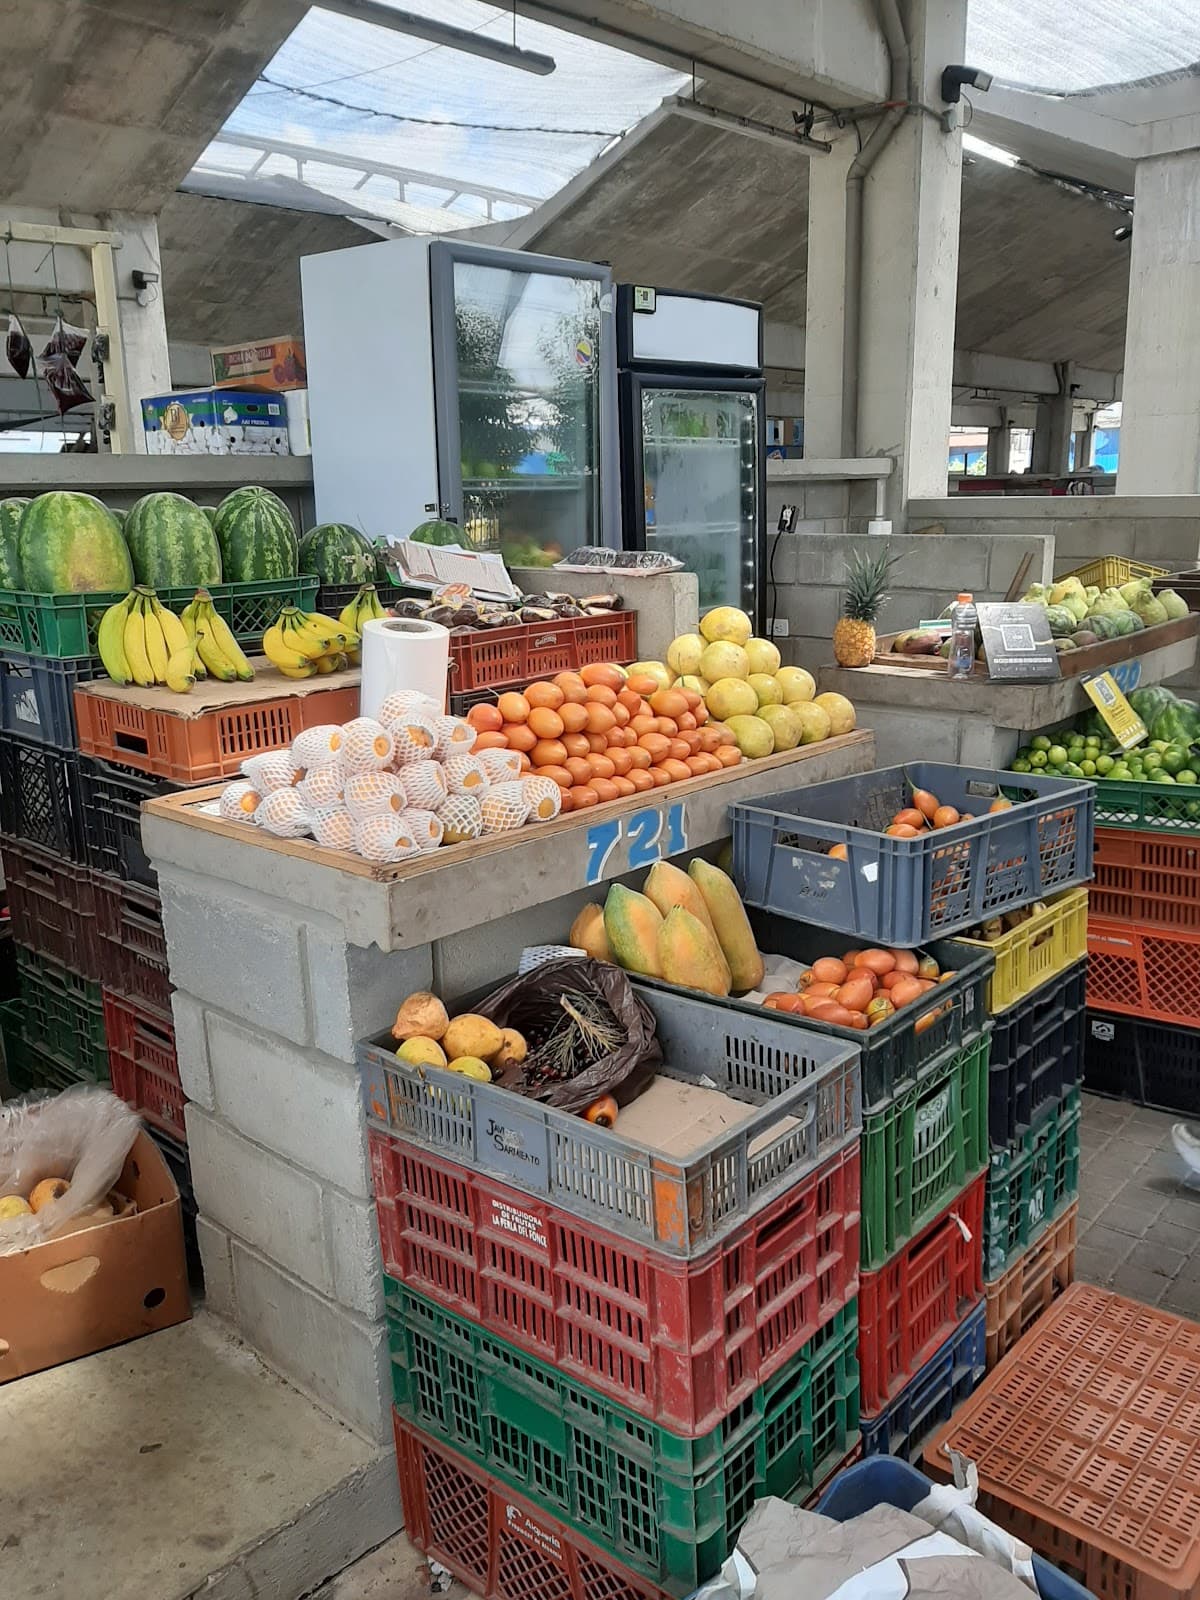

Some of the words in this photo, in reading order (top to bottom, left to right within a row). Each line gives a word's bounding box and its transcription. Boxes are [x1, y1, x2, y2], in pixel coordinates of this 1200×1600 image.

[1109, 660, 1142, 694] 20
[585, 803, 689, 885] 721
[492, 1199, 543, 1228] DISTRIBUIDORA
[492, 1213, 500, 1226] LA
[500, 1217, 517, 1232] PERLA
[518, 1224, 529, 1238] DEL
[501, 1210, 511, 1220] DE
[511, 1214, 537, 1231] FRUTAS
